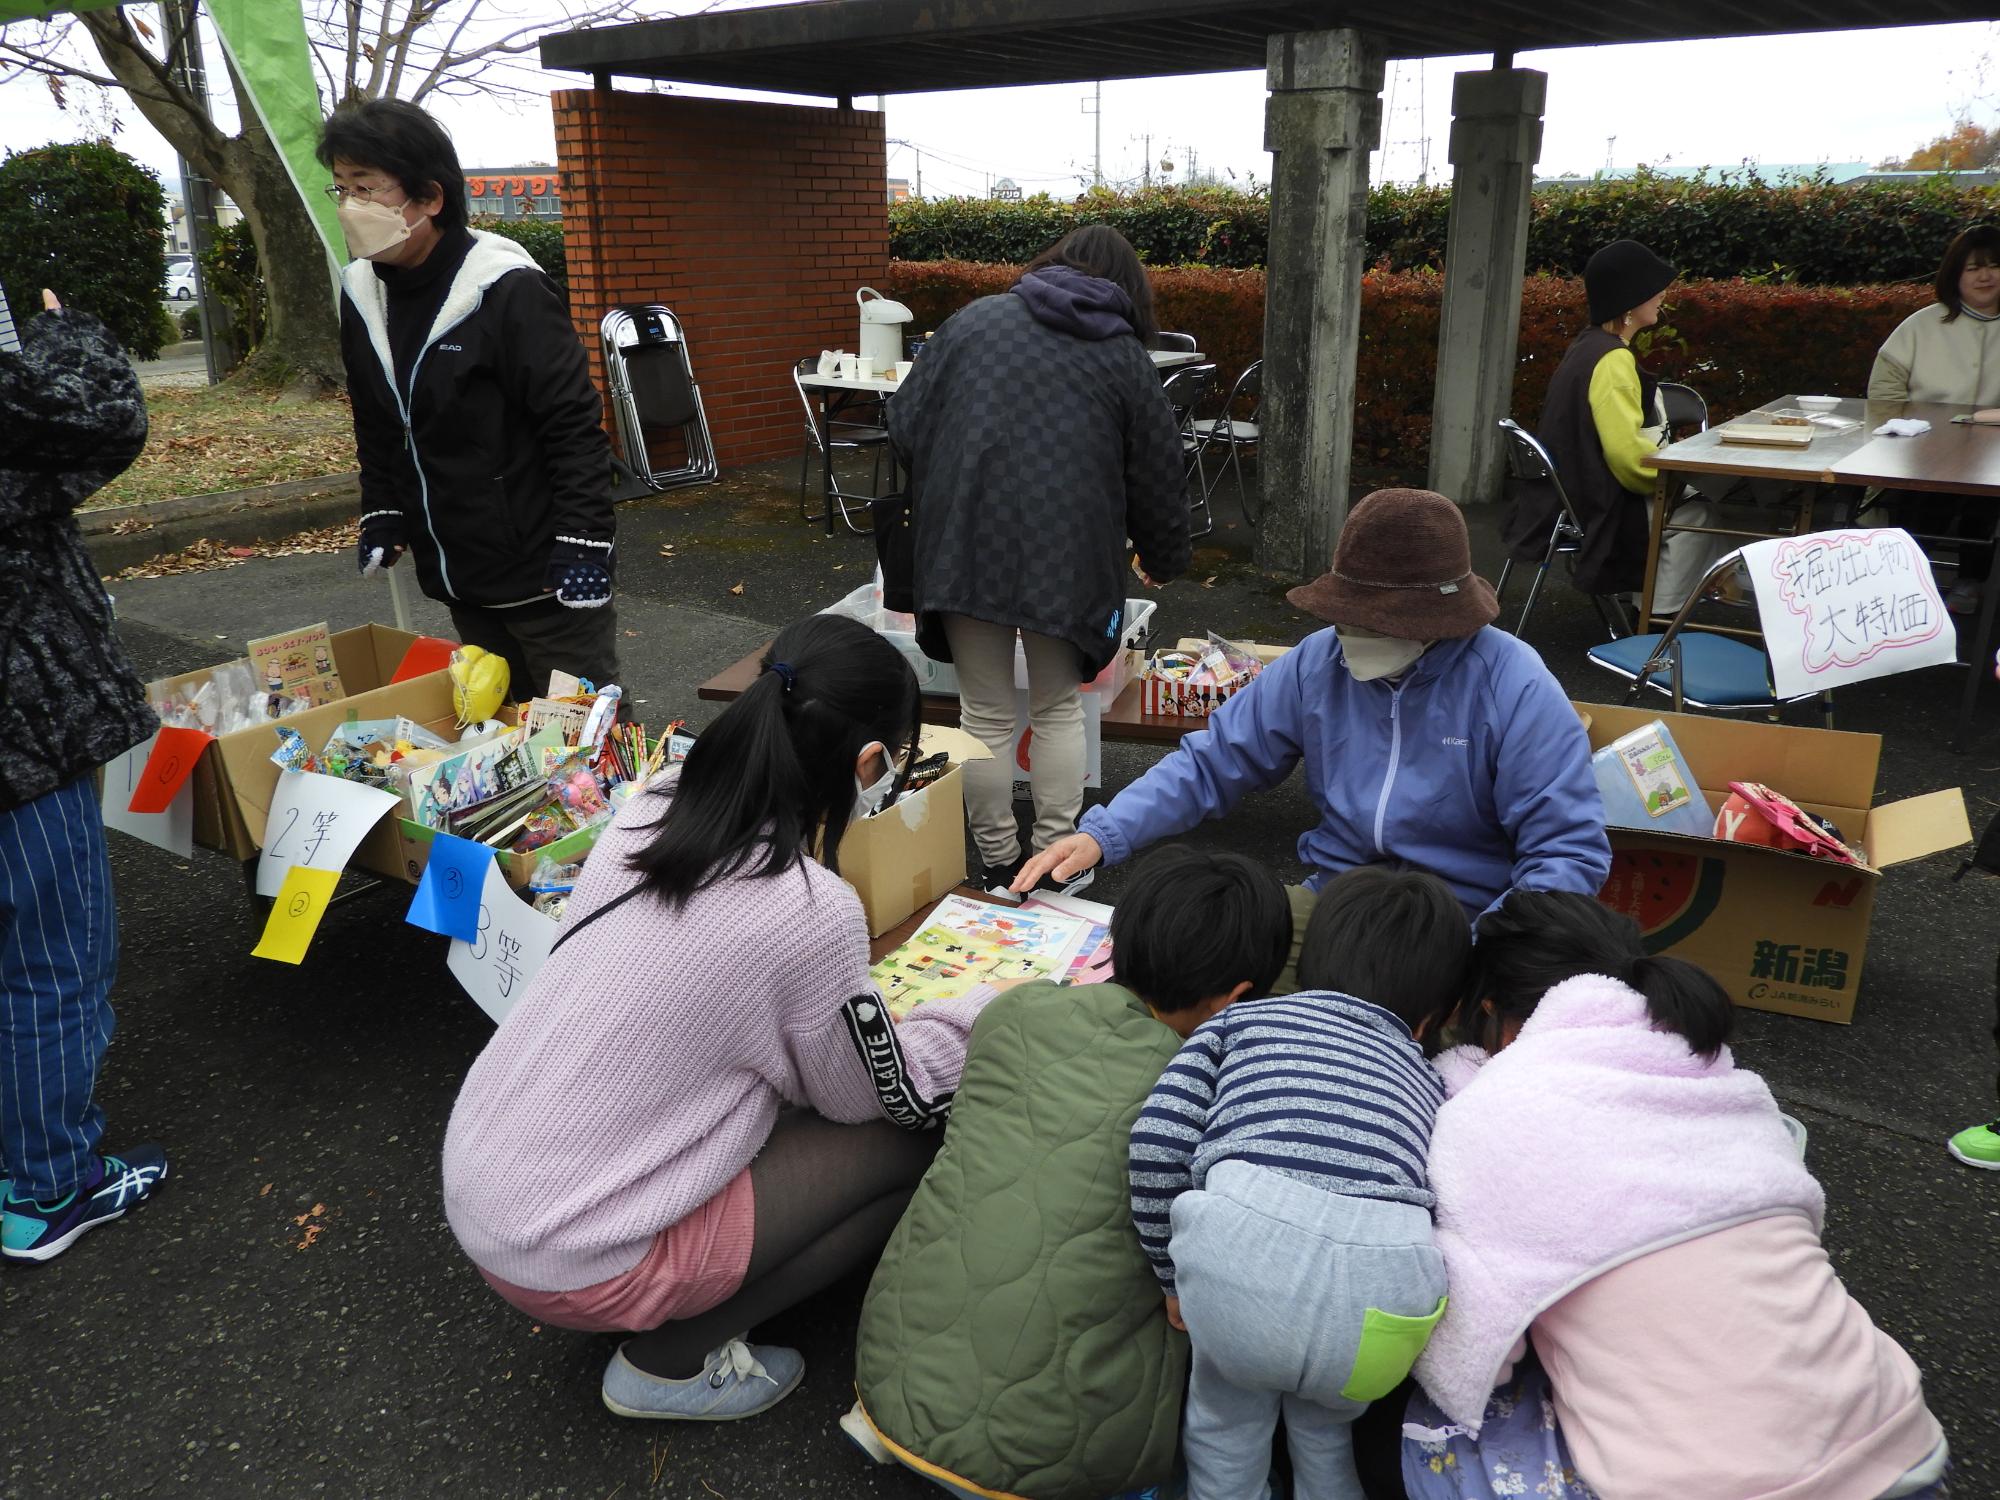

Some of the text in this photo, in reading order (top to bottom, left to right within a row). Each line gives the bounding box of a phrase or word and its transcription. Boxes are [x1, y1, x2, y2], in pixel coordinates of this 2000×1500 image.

[1786, 540, 1909, 598] 掘り出し物
[1819, 593, 1928, 652] 大特価
[268, 807, 340, 866] 2等
[1750, 940, 1848, 991] 新潟
